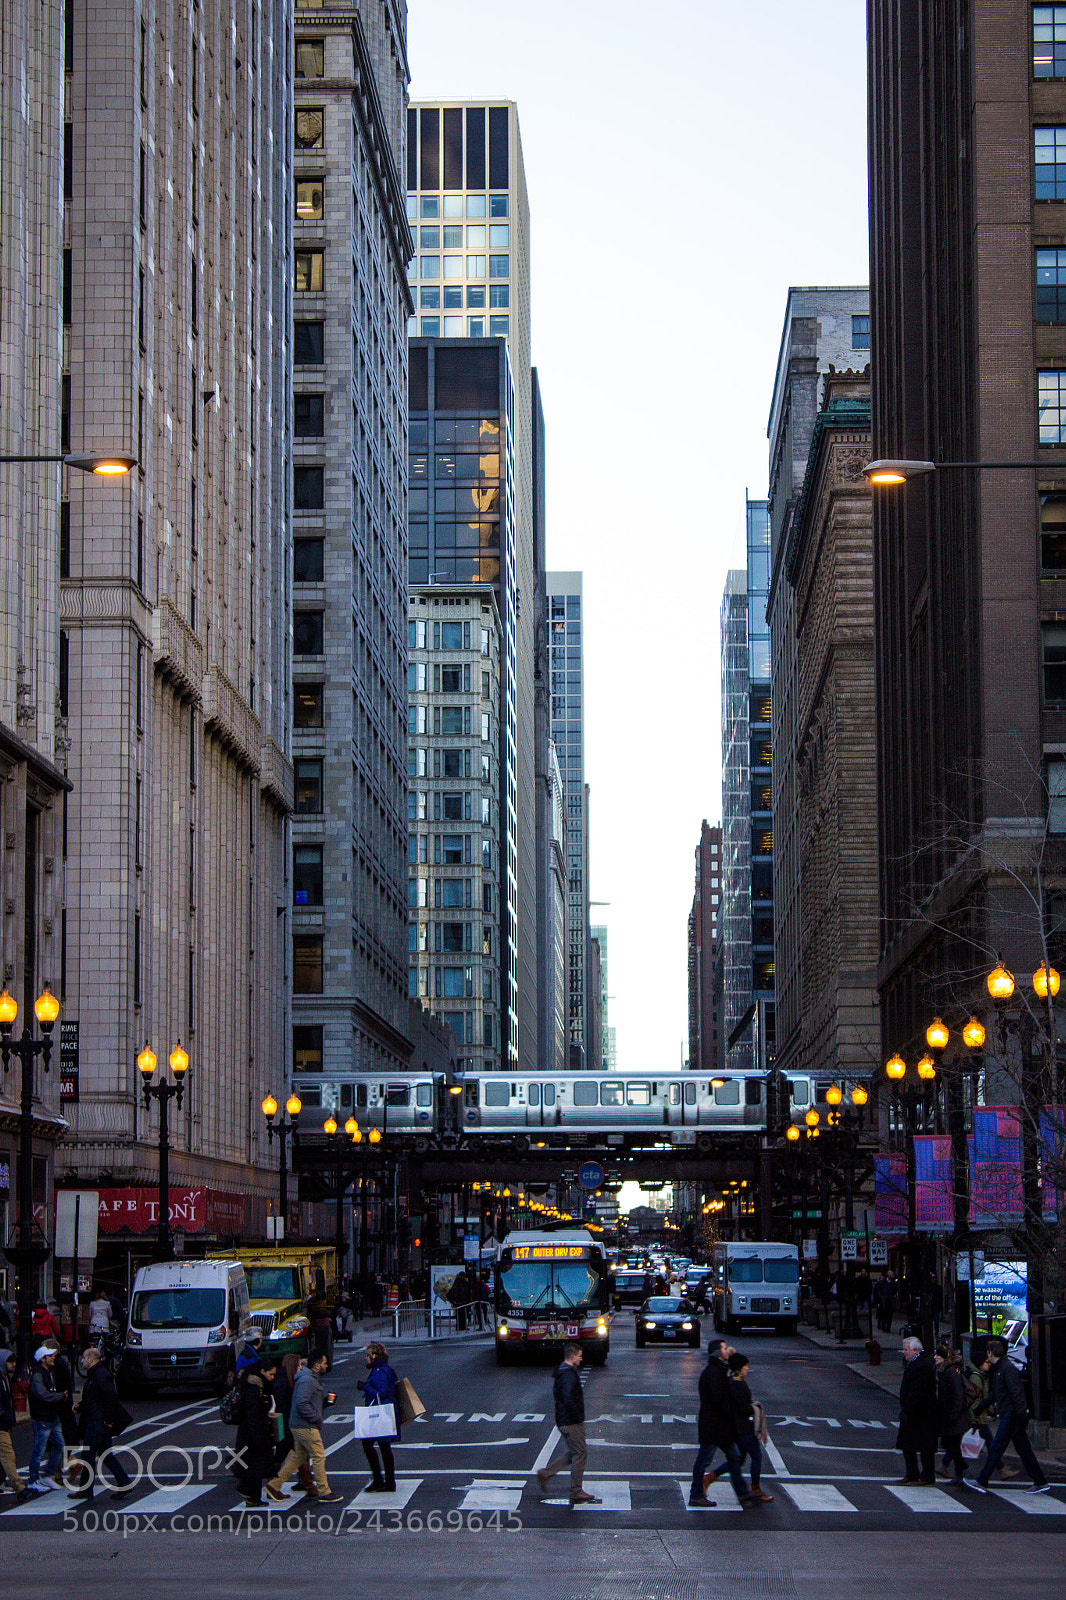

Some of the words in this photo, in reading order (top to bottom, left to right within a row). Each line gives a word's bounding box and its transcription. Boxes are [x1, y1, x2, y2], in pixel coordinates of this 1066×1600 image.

[61, 1024, 78, 1032] RIME
[61, 1042, 78, 1050] PACE
[582, 1171, 600, 1179] cta
[98, 1200, 137, 1211] AFE
[515, 1247, 530, 1259] 147
[533, 1248, 554, 1256] OUTER
[569, 1247, 583, 1256] EXP
[585, 1414, 698, 1424] NLY
[766, 1415, 900, 1428] NLY
